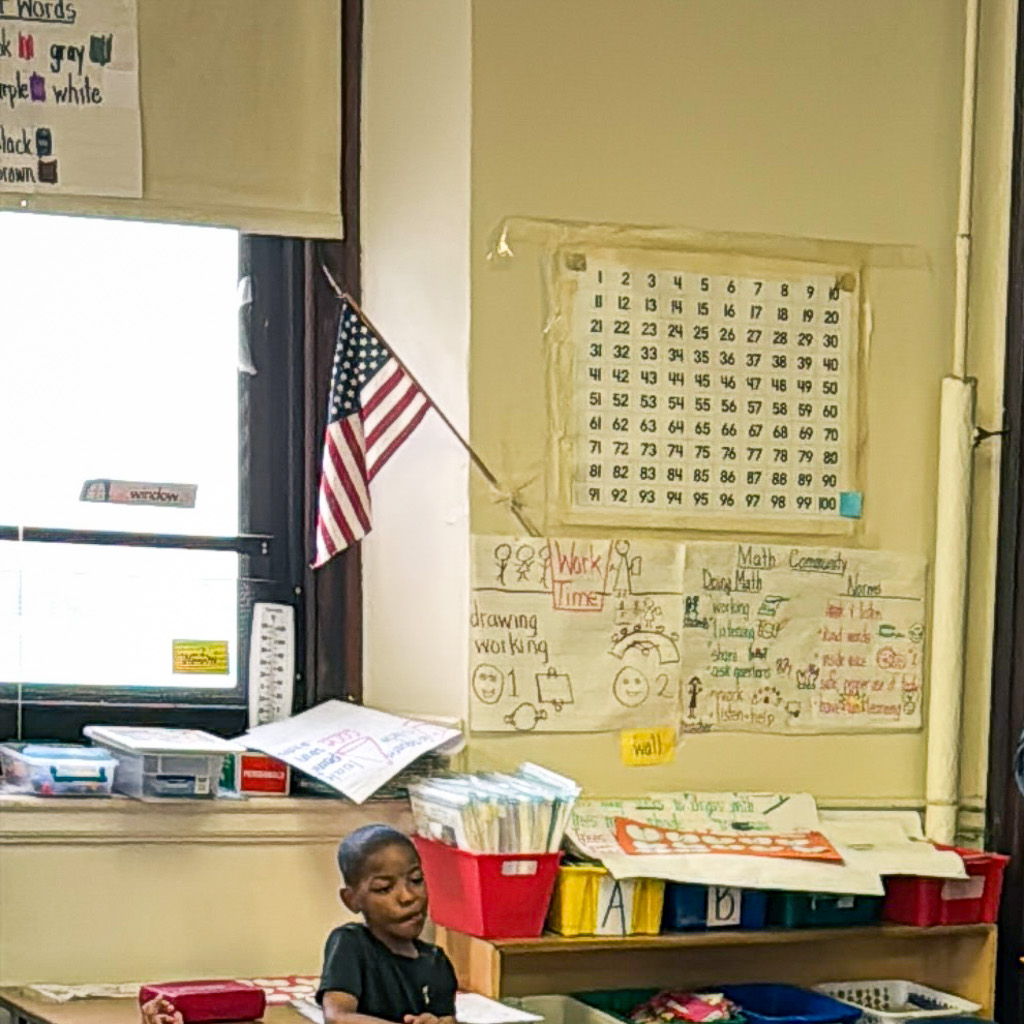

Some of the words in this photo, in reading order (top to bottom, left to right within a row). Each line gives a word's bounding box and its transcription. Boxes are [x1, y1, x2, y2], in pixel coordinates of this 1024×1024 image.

[17, 0, 77, 19] Words
[50, 43, 85, 76] gray
[52, 72, 103, 104] white
[597, 269, 603, 285] 1
[620, 271, 631, 286] 2
[647, 272, 657, 289] 3
[673, 275, 683, 291] 4
[700, 277, 710, 292] 5
[726, 279, 736, 295] 6
[753, 281, 763, 296] 7
[780, 283, 789, 298] 8
[806, 285, 815, 299] 9
[827, 286, 840, 302] 10
[594, 294, 603, 309] 11
[617, 295, 632, 311] 12
[644, 297, 658, 313] 13
[670, 299, 683, 315] 14
[697, 301, 710, 316] 15
[723, 303, 736, 319] 16
[750, 304, 764, 320] 17
[777, 307, 789, 322] 18
[802, 308, 814, 323] 19
[823, 310, 840, 325] 20
[589, 318, 603, 333] 21
[613, 319, 631, 336] 22
[641, 321, 658, 337] 23
[667, 323, 684, 339] 24
[693, 324, 710, 341] 25
[719, 327, 736, 343] 26
[746, 328, 763, 344] 27
[772, 330, 788, 346] 28
[796, 332, 814, 347] 29
[822, 333, 839, 349] 30
[589, 342, 603, 358] 31
[612, 344, 631, 359] 32
[640, 345, 658, 361] 33
[667, 347, 685, 363] 34
[693, 349, 710, 365] 35
[719, 350, 736, 366] 36
[745, 353, 762, 368] 37
[771, 354, 788, 369] 38
[796, 356, 813, 371] 39
[822, 357, 840, 372] 40
[588, 367, 602, 382] 41
[611, 368, 630, 384] 42
[640, 370, 658, 386] 43
[667, 371, 685, 387] 44
[694, 373, 711, 389] 45
[720, 375, 737, 390] 46
[745, 376, 762, 391] 47
[771, 377, 788, 393] 48
[796, 379, 813, 394] 49
[822, 380, 839, 396] 50
[589, 391, 602, 406] 51
[612, 392, 629, 408] 52
[639, 393, 658, 409] 53
[667, 395, 685, 411] 54
[694, 397, 711, 412] 55
[721, 398, 738, 414] 56
[747, 400, 763, 415] 57
[772, 401, 788, 416] 58
[797, 402, 813, 418] 59
[822, 404, 839, 419] 60
[589, 416, 602, 430] 61
[611, 417, 629, 432] 62
[639, 418, 658, 433] 63
[667, 419, 685, 435] 64
[694, 421, 712, 436] 65
[720, 422, 738, 437] 66
[748, 423, 764, 438] 67
[772, 425, 788, 440] 68
[798, 426, 814, 441] 69
[823, 427, 839, 442] 70
[588, 439, 602, 455] 71
[612, 440, 630, 456] 72
[640, 442, 658, 458] 73
[666, 443, 684, 458] 74
[694, 444, 711, 459] 75
[721, 446, 737, 461] 76
[746, 446, 764, 462] 77
[772, 448, 788, 464] 78
[797, 449, 814, 464] 79
[822, 450, 839, 465] 80
[588, 463, 602, 478] 81
[612, 464, 629, 480] 82
[639, 466, 657, 481] 83
[666, 467, 684, 482] 84
[693, 468, 710, 483] 85
[719, 469, 737, 484] 86
[746, 470, 763, 485] 87
[771, 471, 788, 486] 88
[797, 472, 813, 487] 89
[821, 473, 837, 488] 90
[129, 486, 180, 502] window
[588, 487, 601, 502] 91
[610, 488, 628, 503] 92
[638, 489, 656, 504] 93
[666, 490, 683, 505] 94
[692, 491, 709, 507] 95
[719, 492, 735, 507] 96
[745, 493, 761, 508] 97
[770, 494, 787, 510] 98
[795, 495, 813, 510] 99
[817, 496, 838, 512] 100
[554, 540, 602, 576] Work
[738, 544, 777, 567] Math
[553, 579, 599, 608] Time
[736, 569, 762, 591] Math
[470, 599, 538, 635] drawing
[475, 632, 548, 663] working
[508, 668, 519, 697] 1
[656, 674, 674, 699] 2
[632, 733, 662, 756] wall
[602, 879, 627, 936] A
